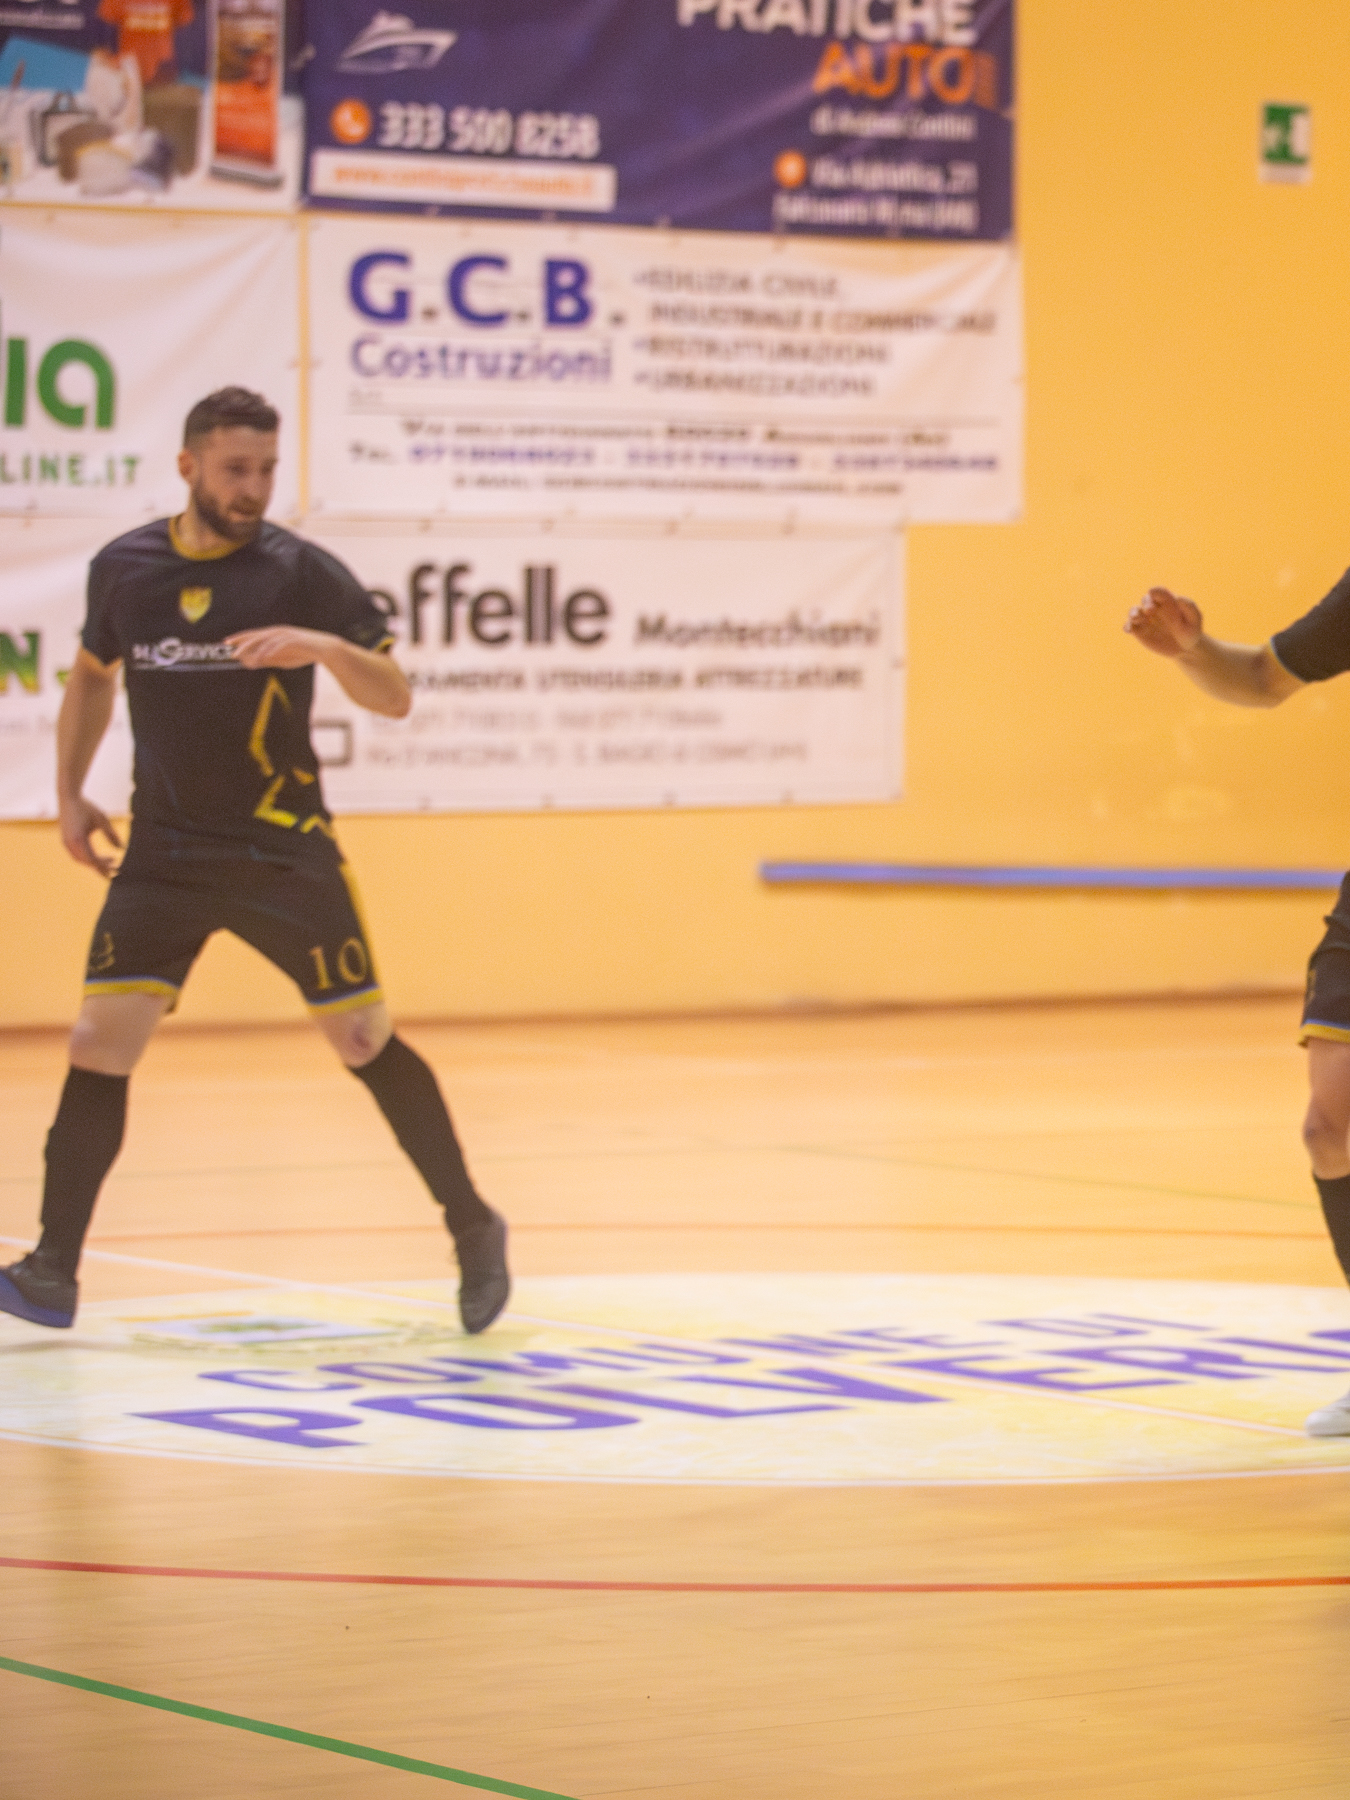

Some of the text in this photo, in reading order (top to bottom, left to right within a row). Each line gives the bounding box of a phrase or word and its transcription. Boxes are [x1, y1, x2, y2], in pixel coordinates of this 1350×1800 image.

[812, 41, 972, 103] AUTO
[378, 100, 446, 149] 333
[348, 250, 624, 329] G.C.B.
[350, 334, 612, 383] Costruzioni
[309, 937, 367, 991] 10
